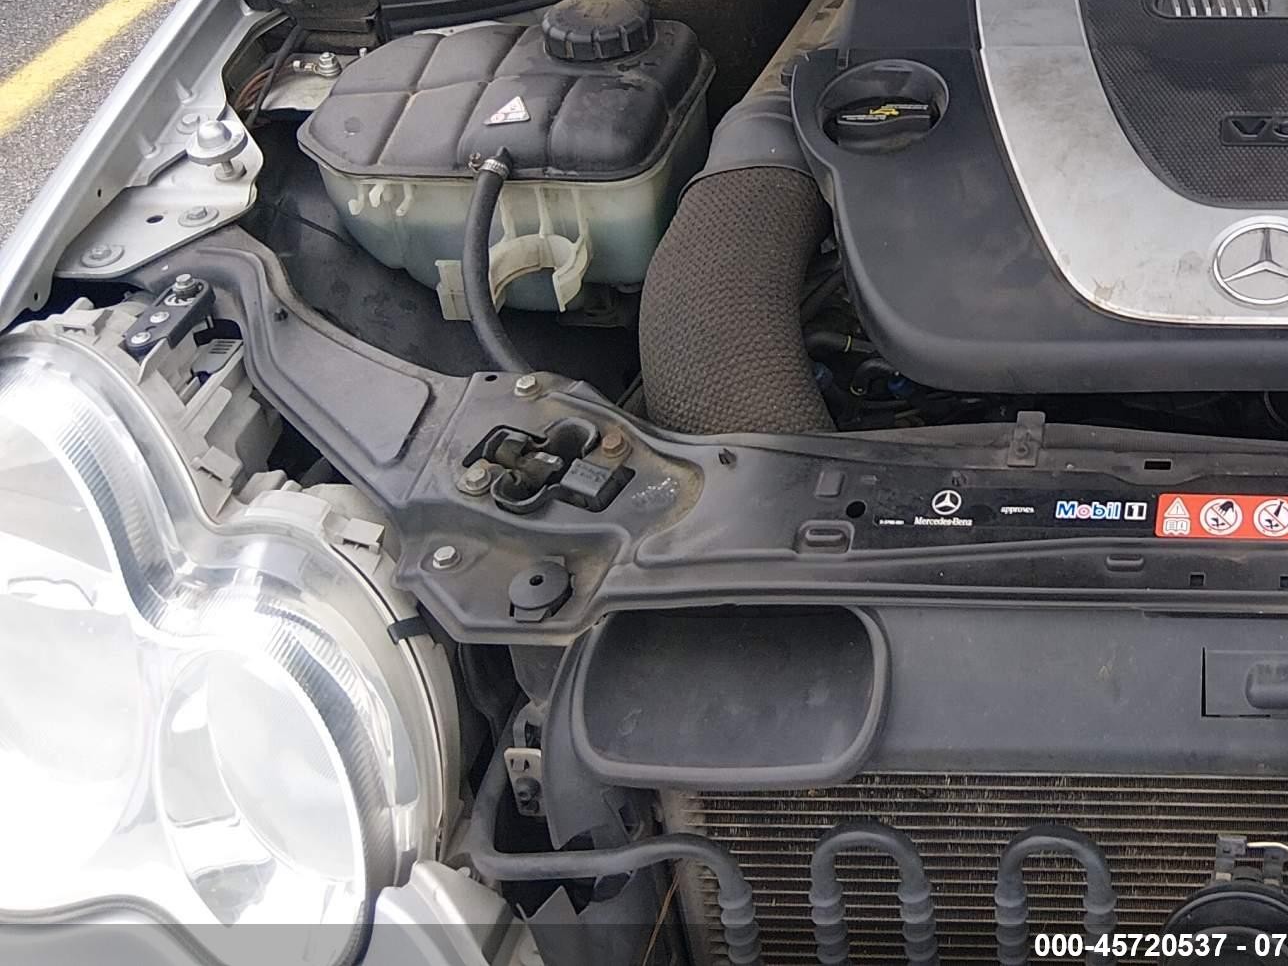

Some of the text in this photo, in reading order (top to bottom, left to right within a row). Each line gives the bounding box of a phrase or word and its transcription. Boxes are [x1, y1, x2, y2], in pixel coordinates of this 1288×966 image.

[1000, 505, 1035, 515] approves
[1055, 501, 1122, 520] Mobil
[914, 516, 973, 527] Mercedes-Benz
